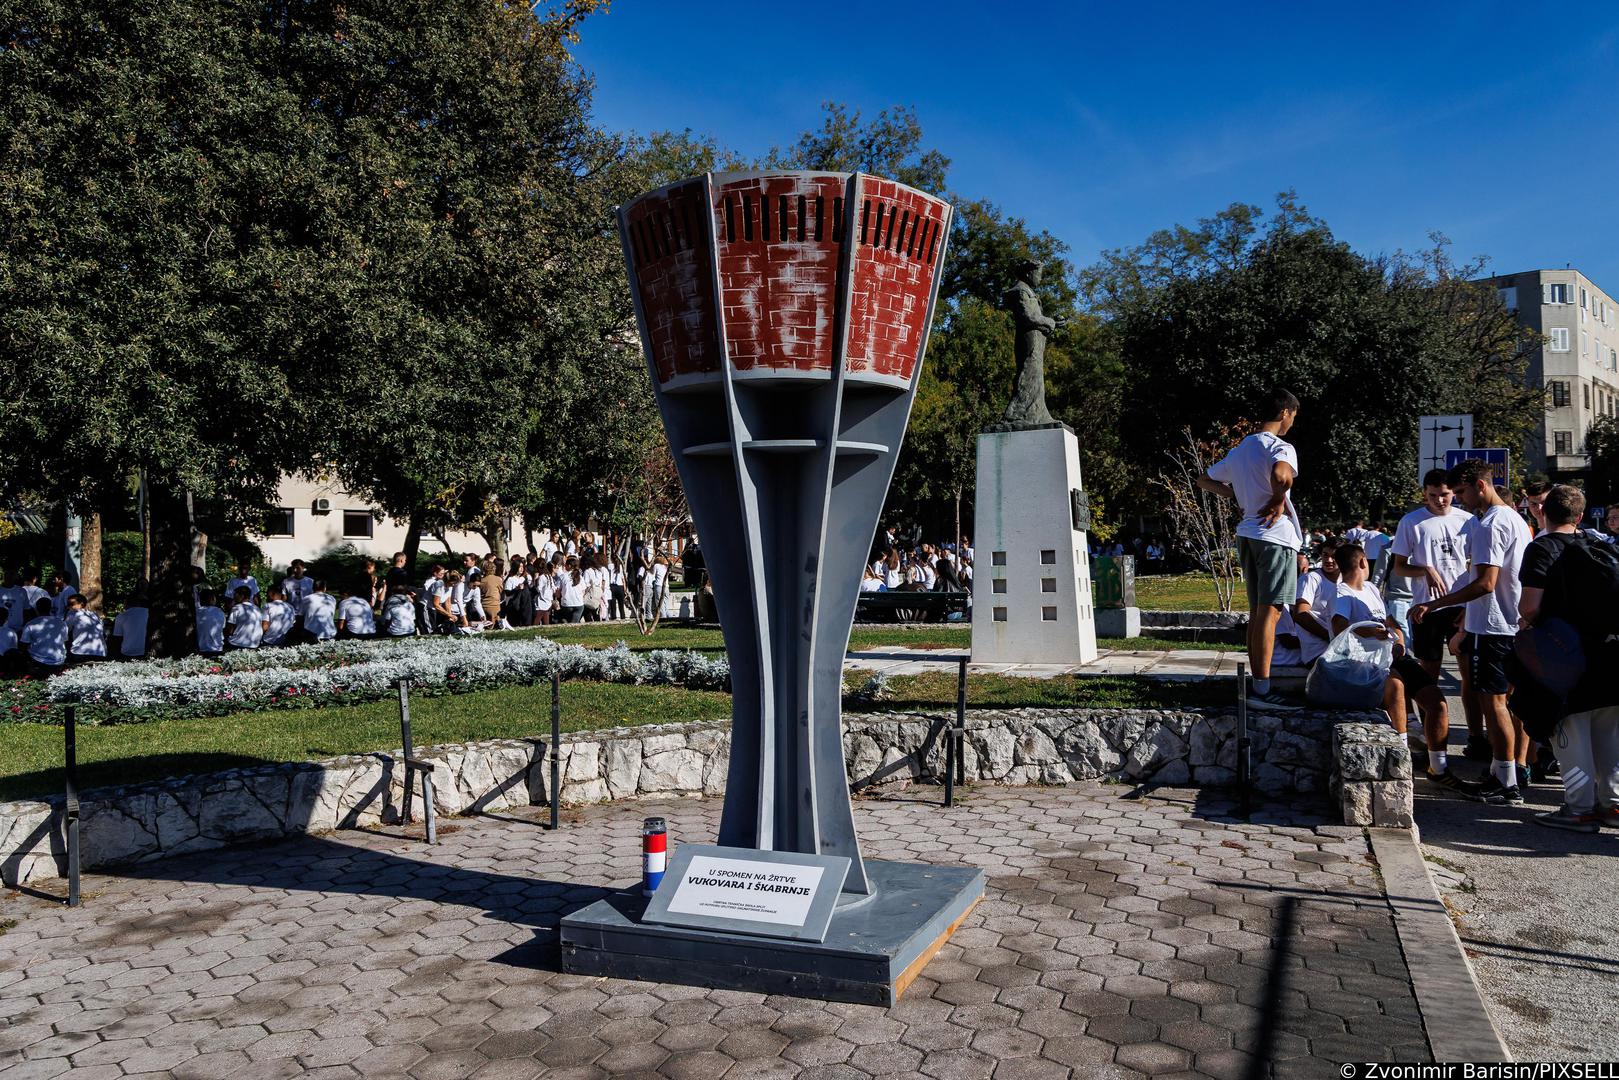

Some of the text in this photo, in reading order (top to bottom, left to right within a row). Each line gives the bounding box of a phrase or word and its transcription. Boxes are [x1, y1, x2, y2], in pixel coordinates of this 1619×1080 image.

[717, 870, 752, 879] SPOMEN
[753, 873, 766, 881] NA
[767, 874, 796, 883] ŽRTVE
[688, 876, 810, 895] VUKOVARA I ŠKABRNJE
